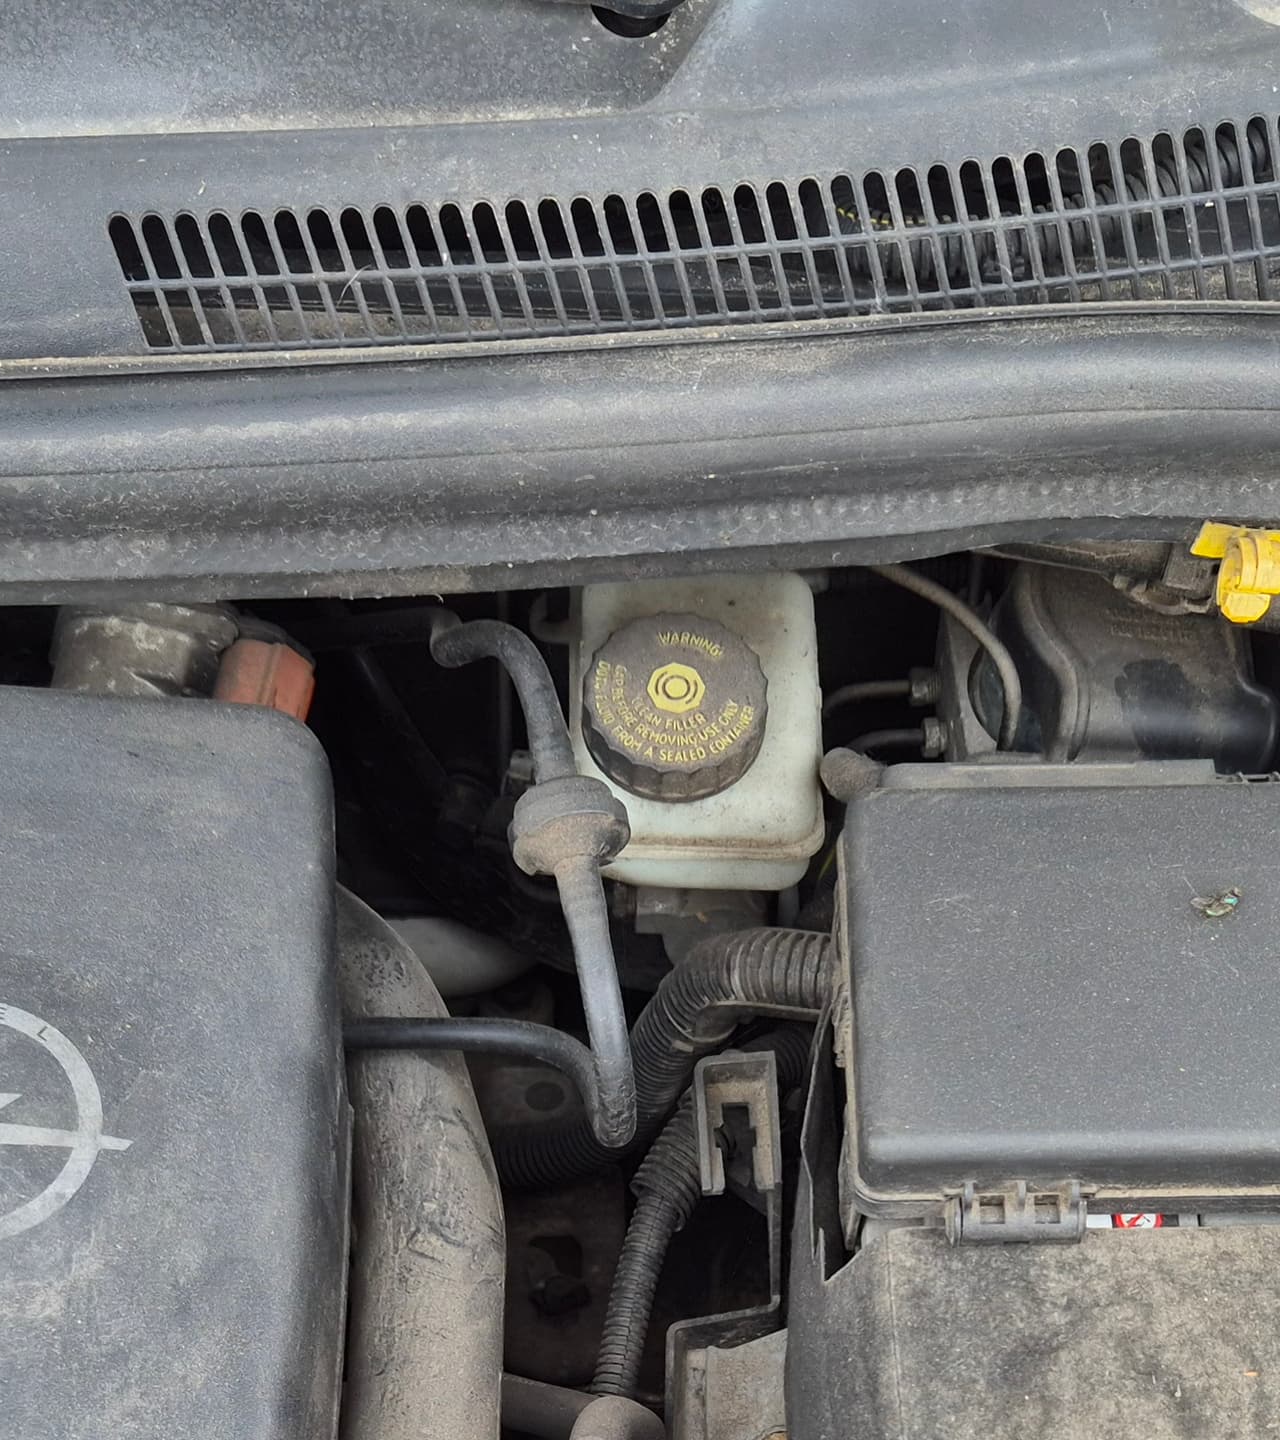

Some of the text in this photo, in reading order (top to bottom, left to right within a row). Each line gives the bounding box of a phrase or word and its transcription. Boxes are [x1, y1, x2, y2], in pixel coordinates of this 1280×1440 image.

[658, 631, 724, 657] WARNING!
[594, 695, 615, 725] FLUID
[611, 724, 643, 752] FROM
[643, 745, 654, 759] A
[658, 745, 706, 762] SEALED
[708, 704, 754, 755] CONTAINER
[611, 687, 638, 728] BEFORE
[699, 722, 721, 741] USE
[718, 697, 739, 726] ONLY
[631, 697, 707, 732] CLEAN FILLER
